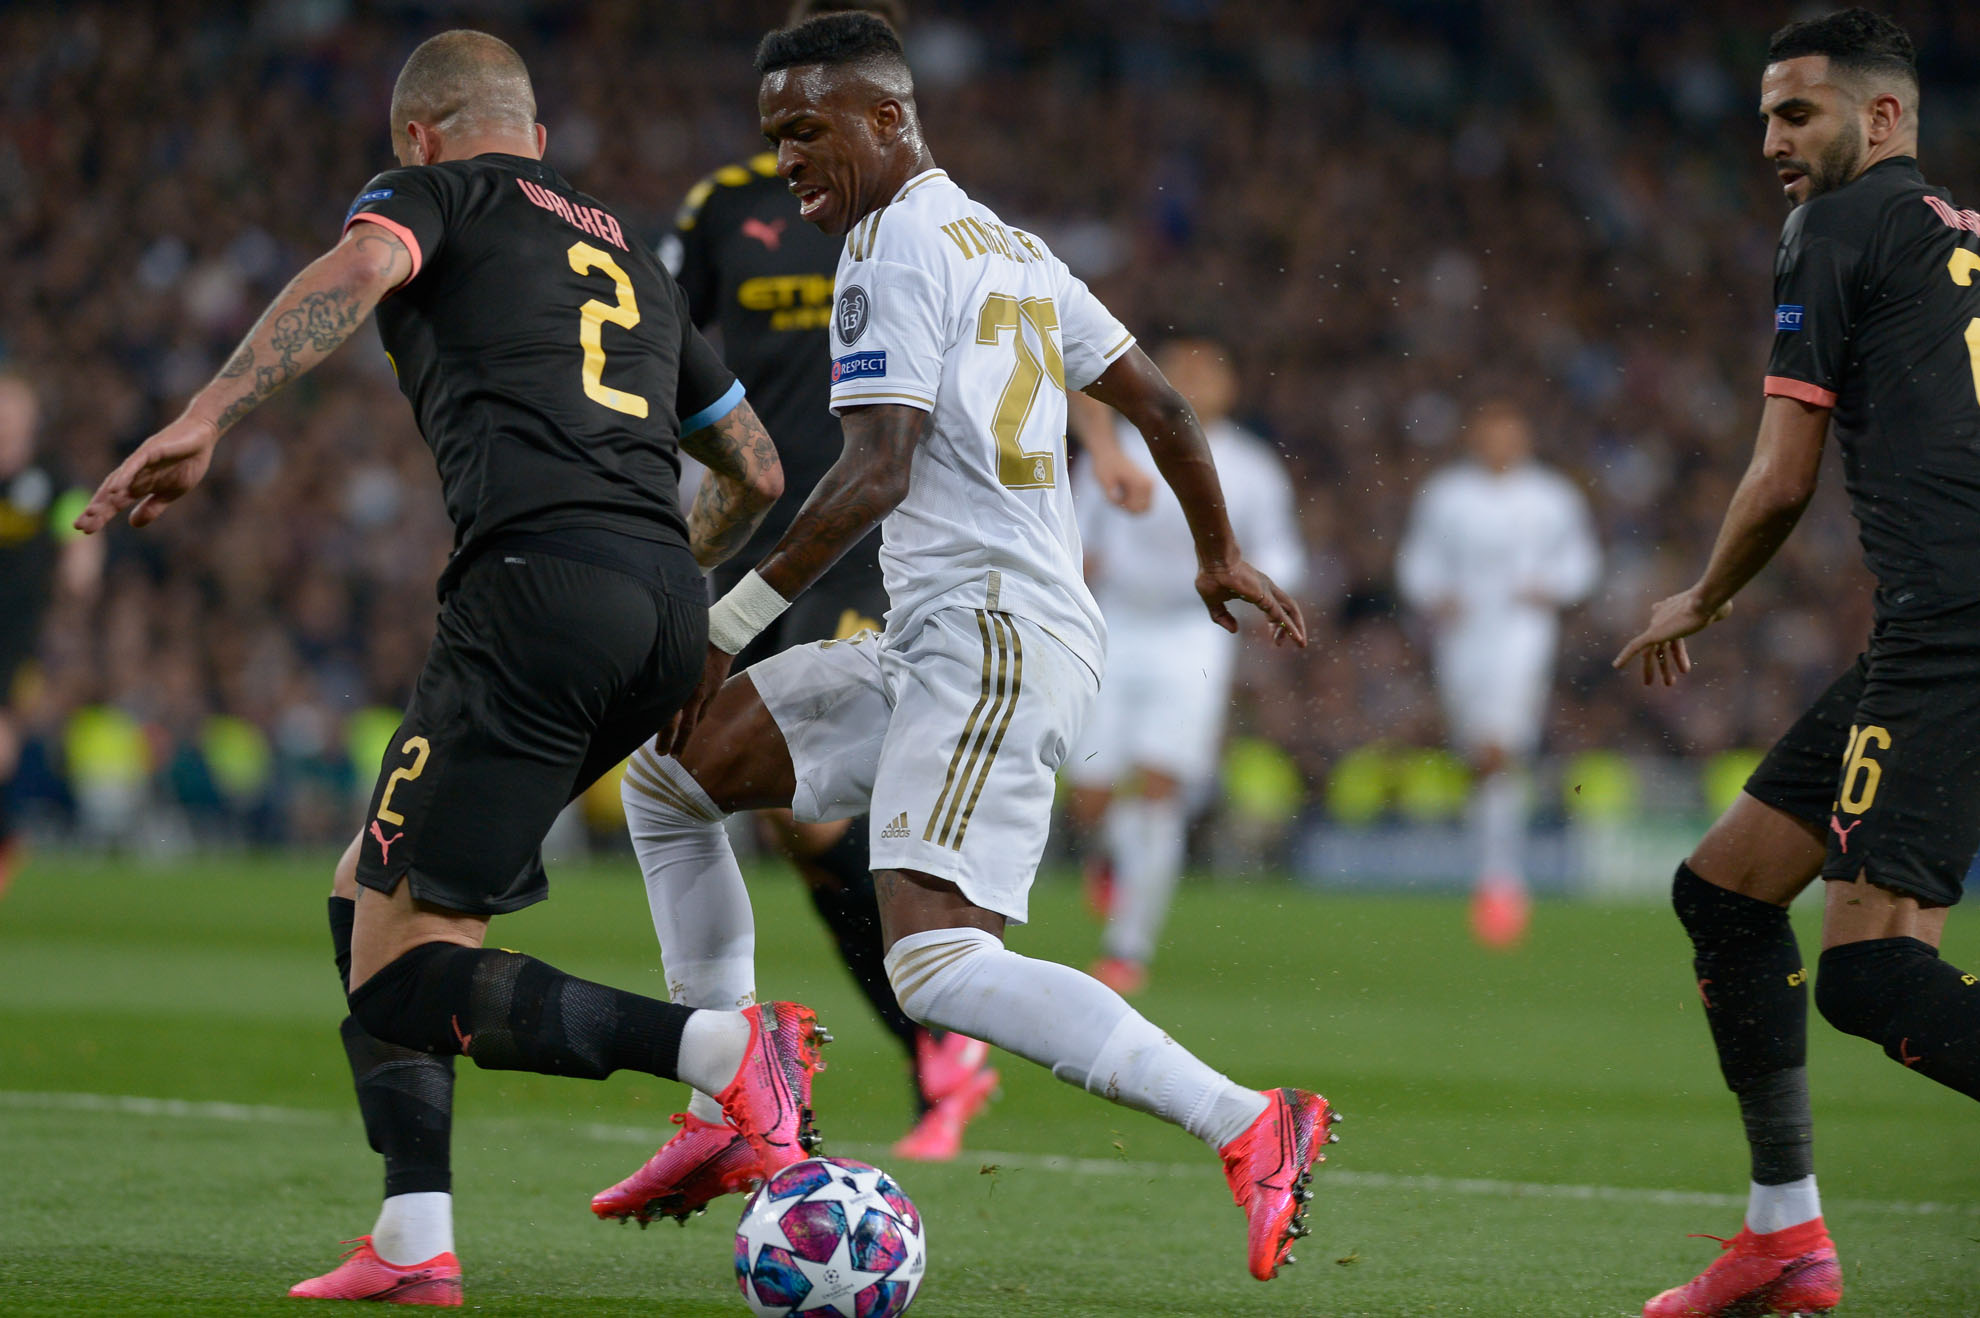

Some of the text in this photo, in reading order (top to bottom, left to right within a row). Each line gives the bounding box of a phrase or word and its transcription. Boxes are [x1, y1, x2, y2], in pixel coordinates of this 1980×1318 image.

[516, 178, 630, 252] WALKER
[567, 240, 649, 420] 2
[844, 315, 857, 331] 13
[841, 358, 885, 375] RESPECT
[377, 735, 431, 827] 2
